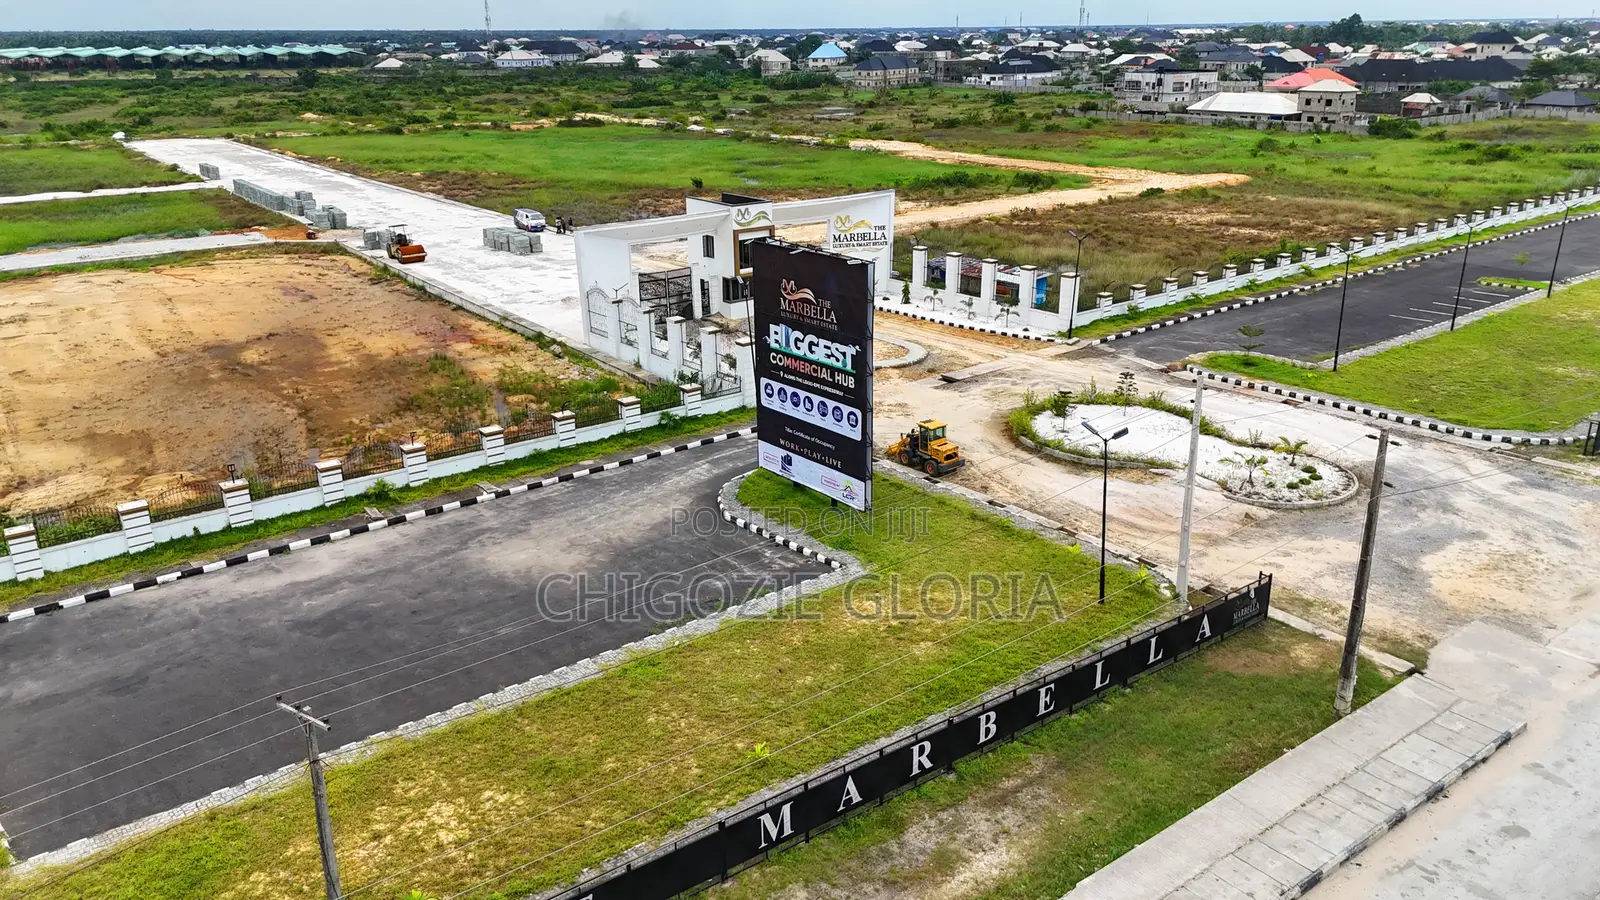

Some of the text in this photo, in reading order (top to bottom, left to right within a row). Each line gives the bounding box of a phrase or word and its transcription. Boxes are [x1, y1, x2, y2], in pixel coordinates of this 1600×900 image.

[832, 232, 887, 243] MARBELLA
[780, 297, 837, 323] MARBELLA
[818, 298, 831, 309] THE
[769, 323, 857, 370] BIGGEST
[769, 352, 855, 389] COMMERCIAL HUB
[779, 437, 841, 469] WORK PLAY LIVE
